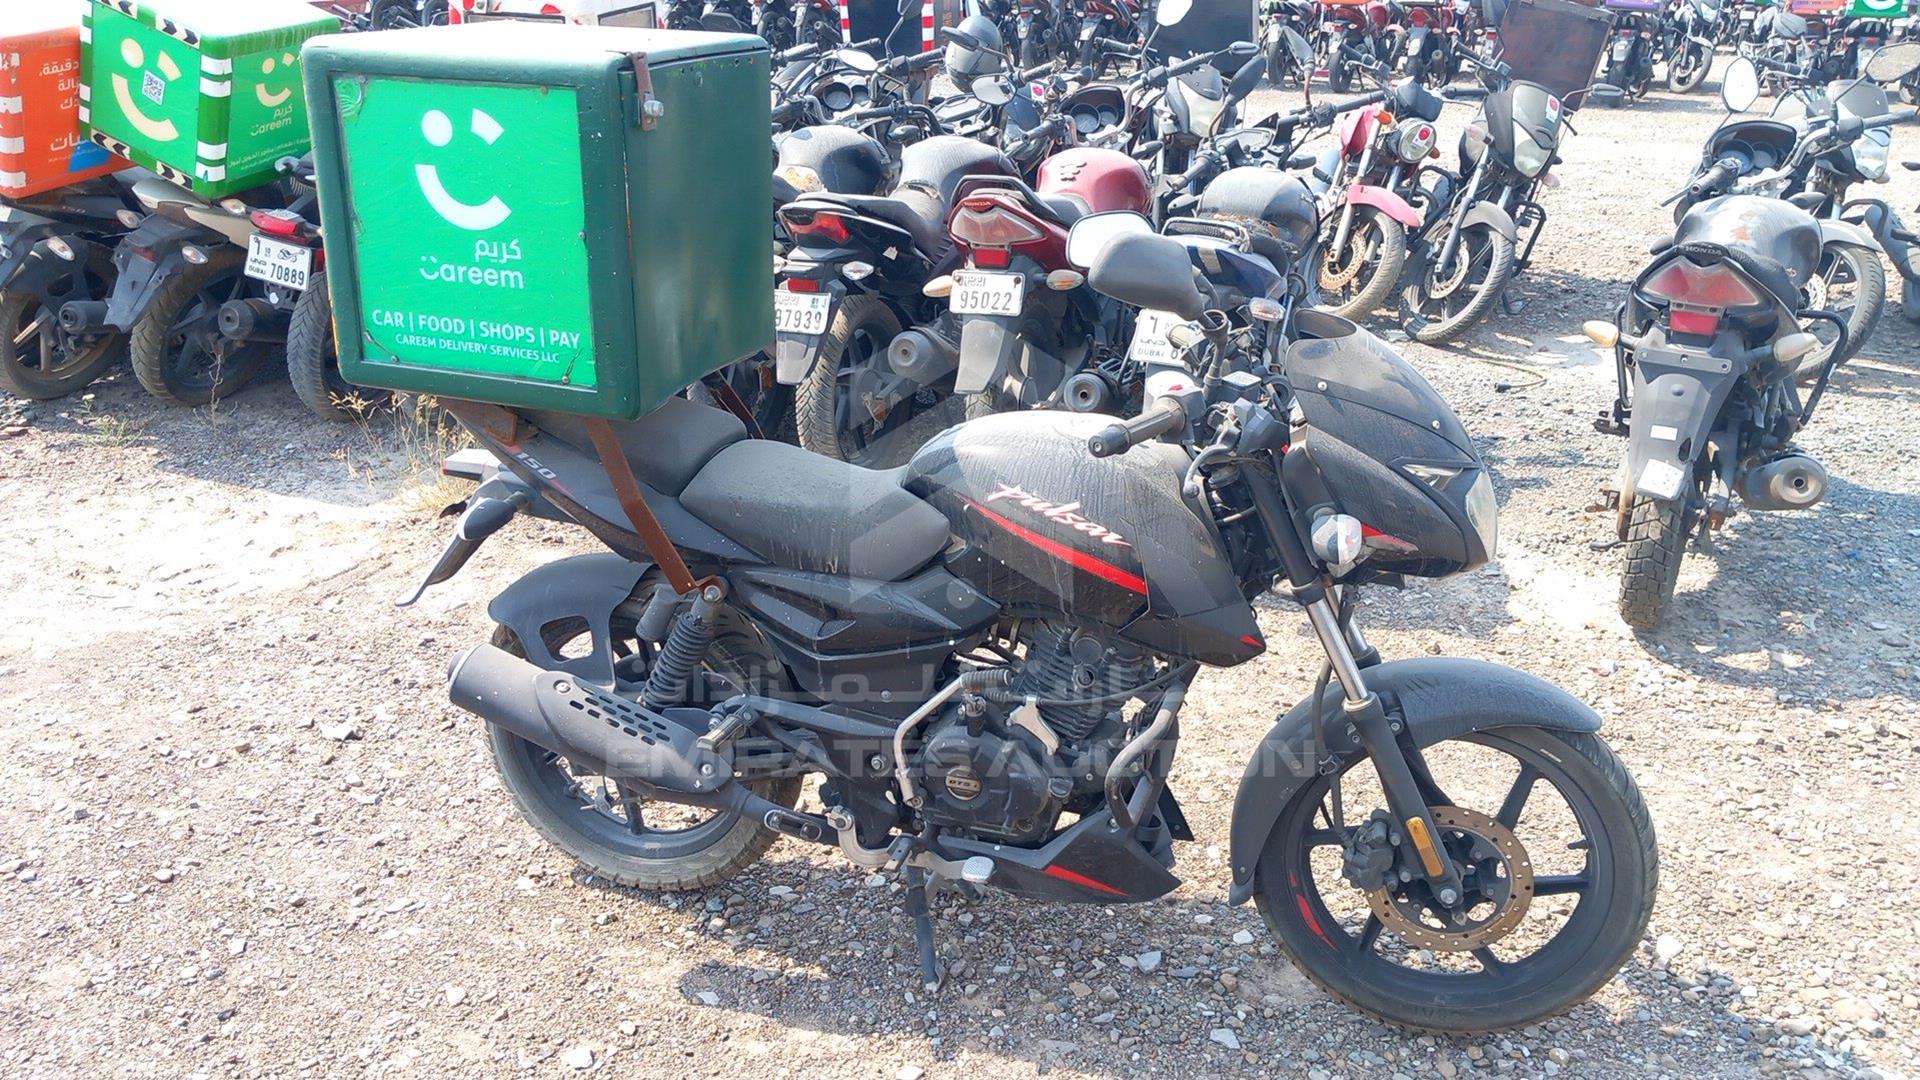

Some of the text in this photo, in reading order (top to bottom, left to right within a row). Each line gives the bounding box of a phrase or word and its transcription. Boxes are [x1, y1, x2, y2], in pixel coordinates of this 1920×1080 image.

[475, 238, 522, 263] كريم
[1685, 245, 1722, 255] HONDA
[270, 262, 305, 286] 70889
[419, 255, 524, 289] Careem
[960, 290, 1012, 311] 95022
[372, 309, 405, 328] CAR
[418, 314, 465, 335] FOOD
[479, 320, 536, 343] SHOPS
[549, 329, 580, 349] PAY
[395, 334, 560, 364] CAREEM DELIVERY SERVICES LLC
[1137, 347, 1166, 357] DUBAI
[516, 452, 557, 479] 150
